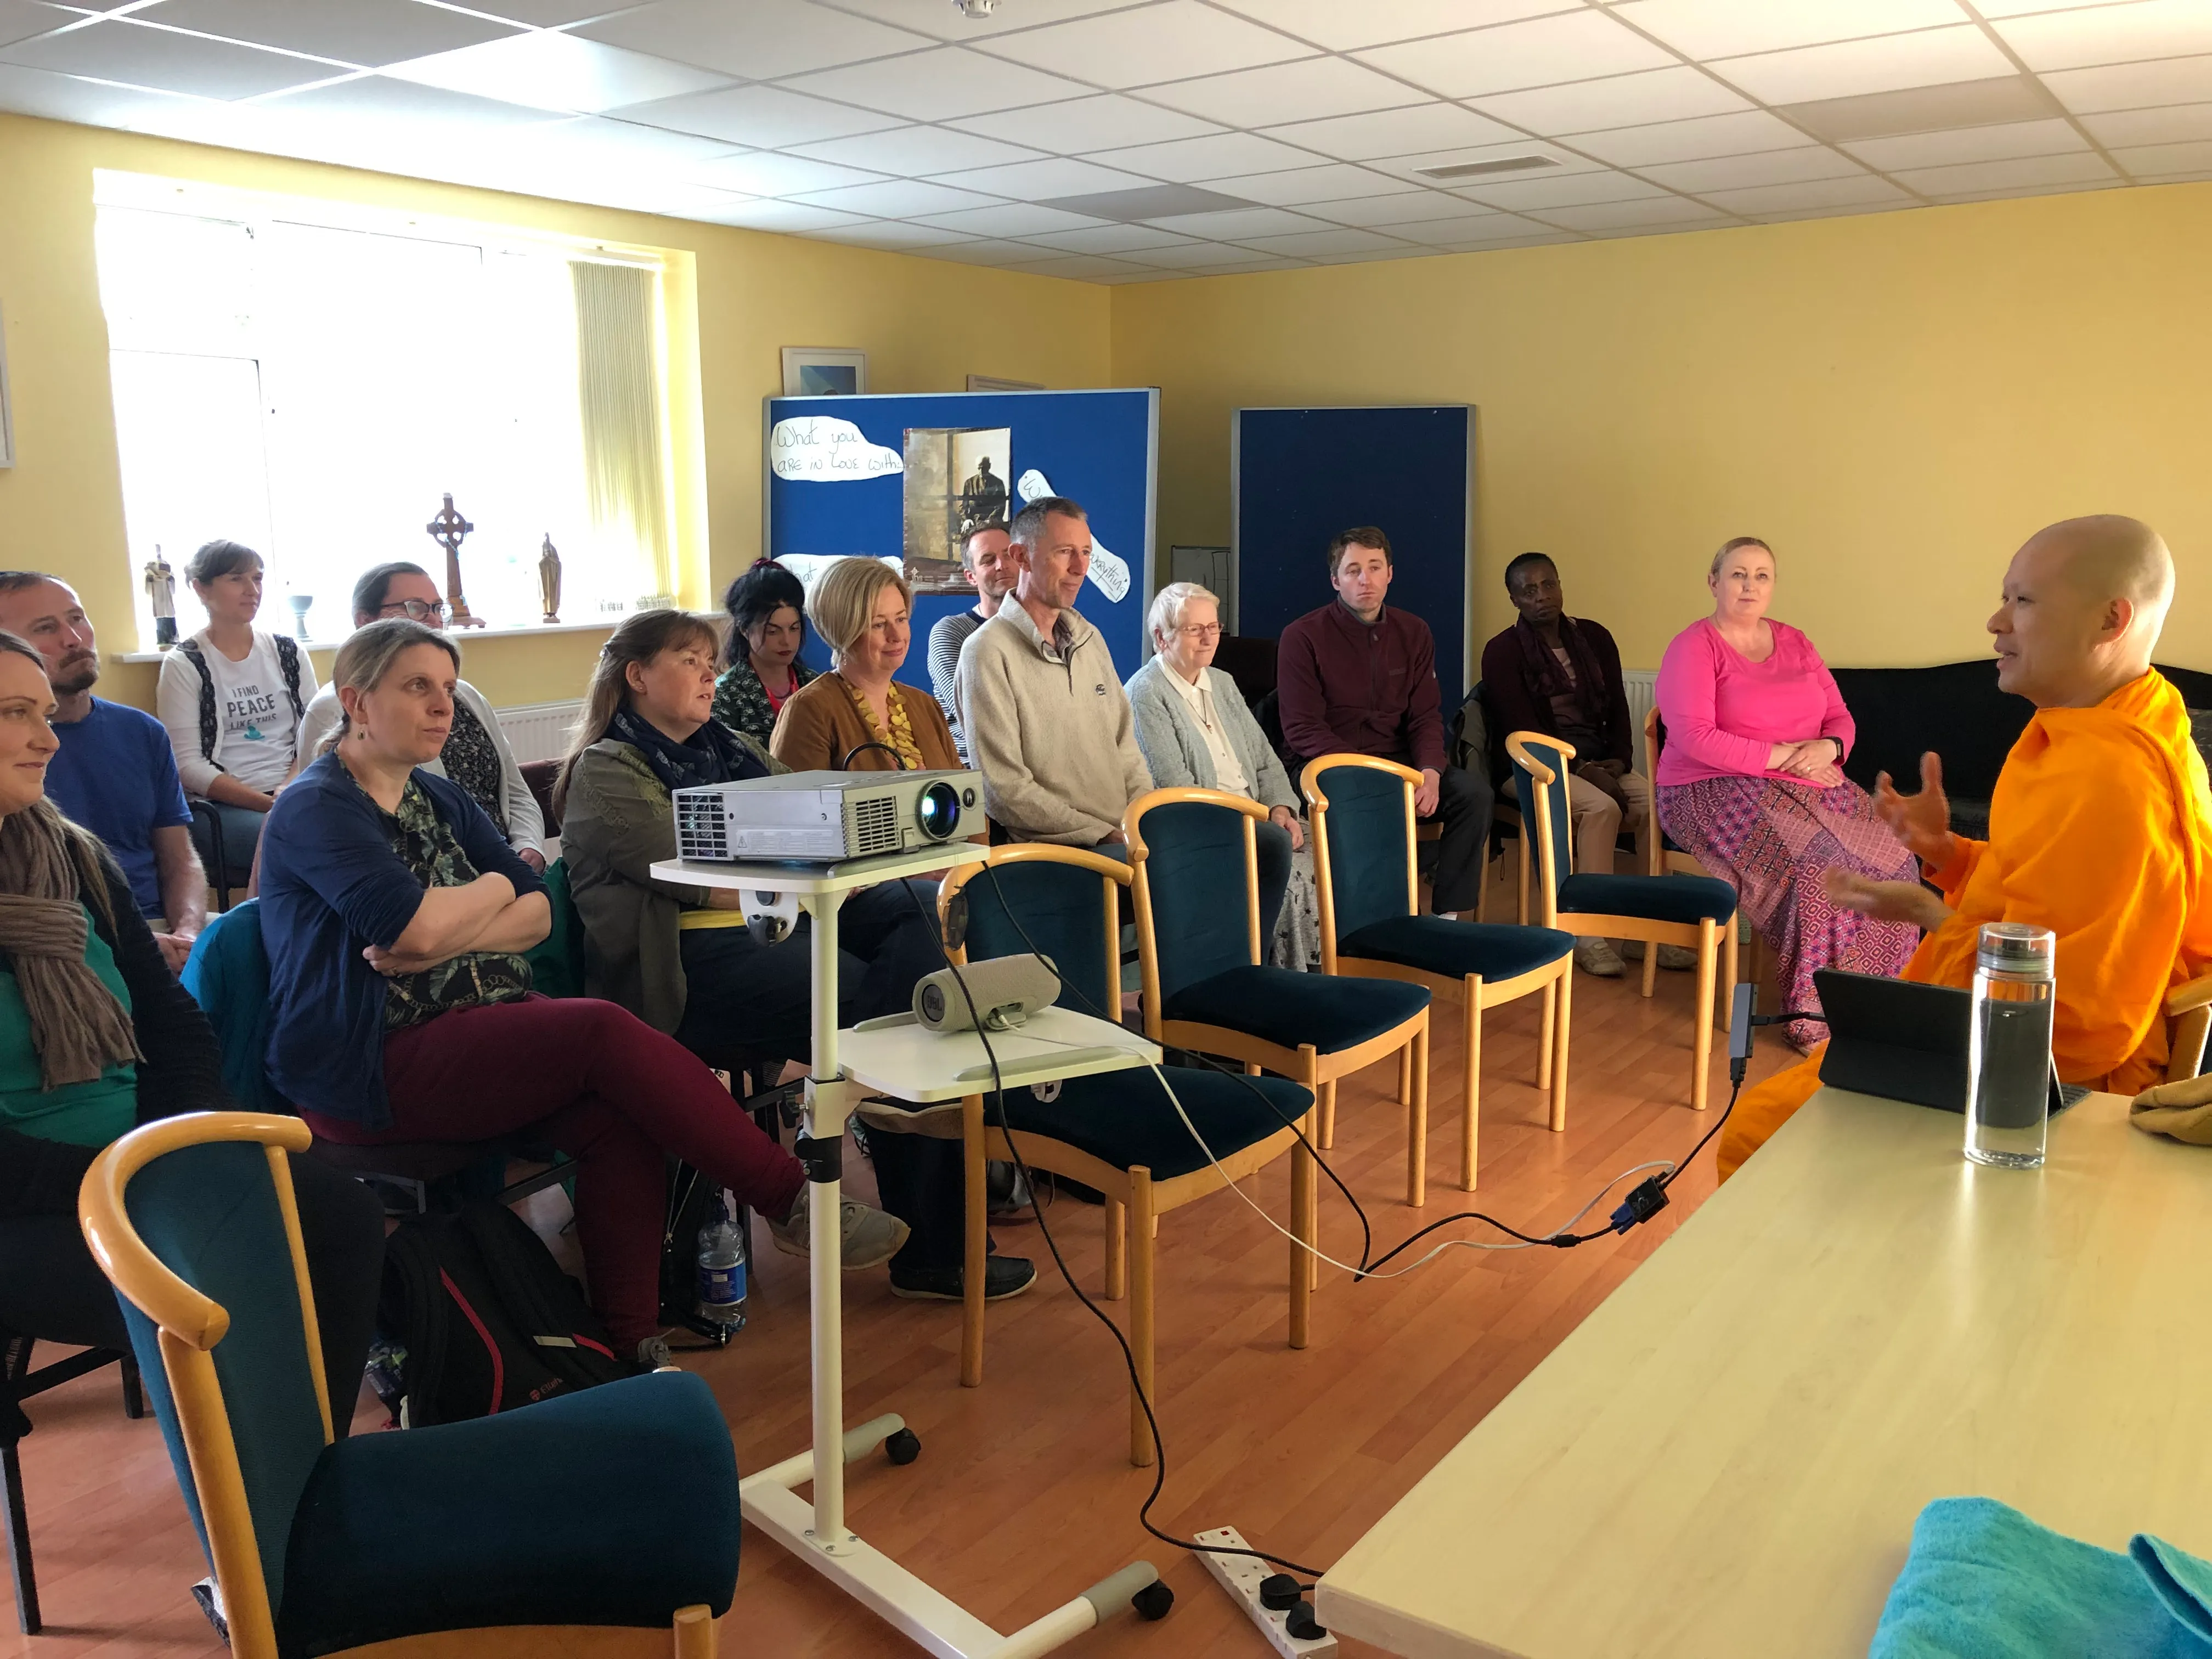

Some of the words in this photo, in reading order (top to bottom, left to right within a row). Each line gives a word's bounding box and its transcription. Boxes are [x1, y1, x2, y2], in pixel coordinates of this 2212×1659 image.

[776, 419, 820, 447] What
[828, 433, 857, 454] you
[789, 561, 817, 582] hat
[232, 689, 237, 698] I
[237, 685, 259, 697] FIND
[227, 693, 275, 718] PEACE
[230, 719, 253, 730] LIKE
[256, 713, 277, 723] THIS
[927, 995, 943, 1011] JBL
